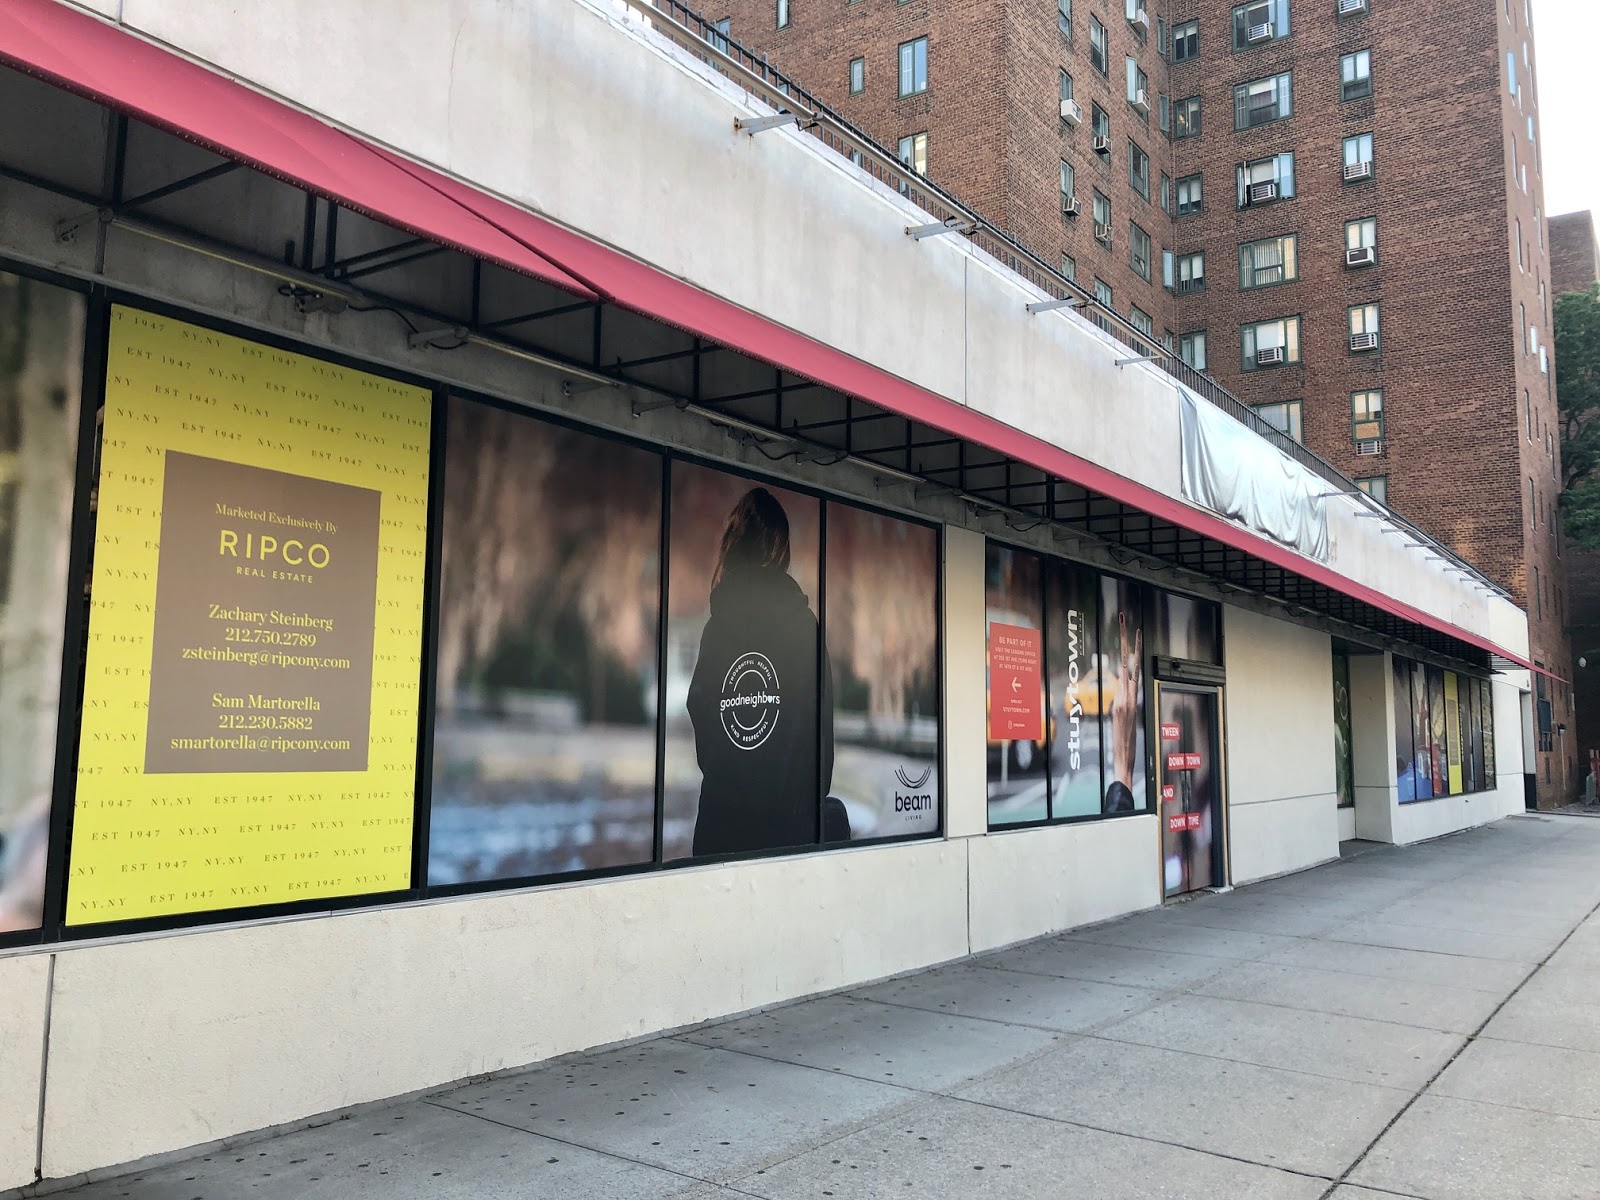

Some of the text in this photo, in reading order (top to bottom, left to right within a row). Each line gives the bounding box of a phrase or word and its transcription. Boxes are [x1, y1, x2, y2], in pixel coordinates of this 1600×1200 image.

[134, 317, 165, 332] 1947
[241, 346, 263, 359] EST
[272, 355, 297, 368] 1947
[361, 379, 380, 390] EST
[387, 386, 409, 399] 1947
[127, 347, 152, 359] EST
[161, 356, 192, 370] 1947
[266, 382, 287, 394] EST
[294, 390, 319, 401] 1947
[382, 412, 402, 422] EST
[407, 418, 428, 429] 1947
[155, 385, 179, 397] EST
[189, 393, 218, 406] 1947
[289, 417, 310, 427] EST
[317, 423, 341, 435] 1947
[402, 443, 421, 452] EST
[182, 422, 206, 434] EST
[215, 430, 242, 442] 1947
[311, 449, 332, 460] EST
[338, 456, 363, 467] 1947
[123, 474, 154, 486] 1947
[116, 505, 142, 516] EST
[216, 503, 338, 535] Marketed Exclusively By
[219, 529, 330, 568] RIPCO
[401, 548, 423, 557] 1947
[236, 566, 314, 584] REAL ESTATE
[396, 574, 415, 582] EST
[209, 603, 334, 631] Zachary Steinberg
[112, 635, 144, 644] 1947
[225, 627, 317, 647] 212.750.2789
[998, 636, 1032, 648] BE PART OF IT
[182, 647, 350, 670] zsteinberg@ripcony.com
[105, 668, 131, 676] EST
[757, 661, 773, 681] HELPFUL
[1066, 609, 1083, 770] stuytown
[212, 693, 321, 711] Sam Martorella
[390, 709, 408, 717] EST
[218, 714, 313, 730] 212.230.5882
[730, 724, 741, 738] KIND
[1162, 727, 1179, 737] TWEEN
[170, 735, 350, 752] smartorella@ripcony.com
[1168, 756, 1201, 767] DOWN TOWN
[214, 796, 237, 804] EST
[246, 795, 273, 803] 1947
[341, 792, 360, 800] EST
[1163, 787, 1174, 798] AND
[895, 791, 932, 812] beam
[1170, 815, 1199, 829] DOWN TIME
[92, 832, 118, 840] EST
[129, 829, 161, 838] 1947
[122, 863, 147, 872] EST
[157, 861, 188, 870] 1947
[264, 854, 286, 862] EST
[293, 851, 319, 860] 1947
[150, 893, 175, 903] EST
[184, 890, 214, 900] 1947
[288, 882, 310, 890] EST
[317, 879, 342, 887] 1947
